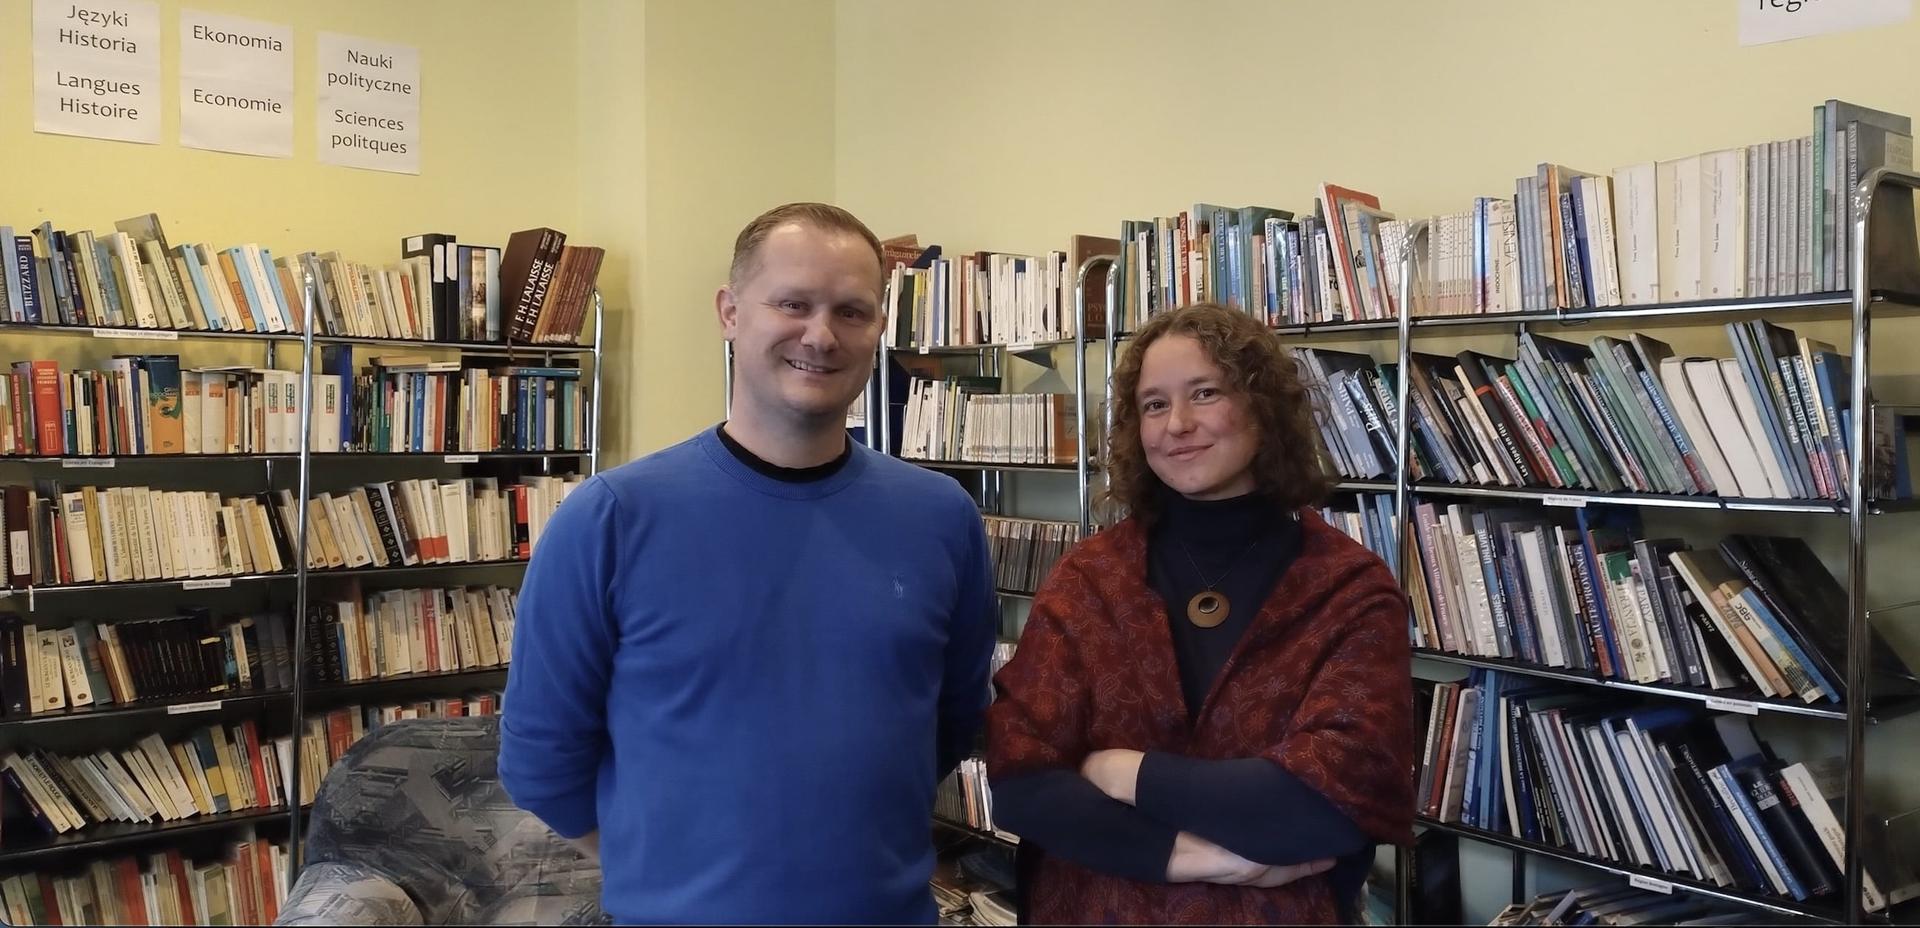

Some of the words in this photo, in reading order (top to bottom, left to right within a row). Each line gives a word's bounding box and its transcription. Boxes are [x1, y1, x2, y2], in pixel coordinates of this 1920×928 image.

[66, 4, 128, 28] Języki
[59, 28, 137, 54] Historia
[193, 25, 283, 52] Ekonomia
[347, 49, 393, 69] Nauki
[56, 71, 141, 96] Langues
[327, 71, 412, 96] polityczne
[60, 97, 138, 121] Histoire
[193, 88, 283, 114] Economie
[334, 108, 404, 132] Sciences
[331, 133, 407, 155] politques
[1502, 214, 1517, 268] VENISE
[20, 256, 33, 306] BLIZZARD
[521, 259, 544, 303] LALAISSE
[533, 261, 554, 307] LALAISSE
[1338, 382, 1354, 415] PARIS
[1361, 402, 1381, 432] Paris
[1497, 422, 1506, 437] fête
[1505, 436, 1512, 446] en
[1510, 446, 1522, 465] Alpes
[1519, 464, 1528, 477] Les
[1492, 594, 1506, 627] RENNES
[1617, 585, 1637, 637] FRANCJA
[1513, 744, 1523, 771] BRETAGNE
[1683, 750, 1702, 779] BRETAGNE
